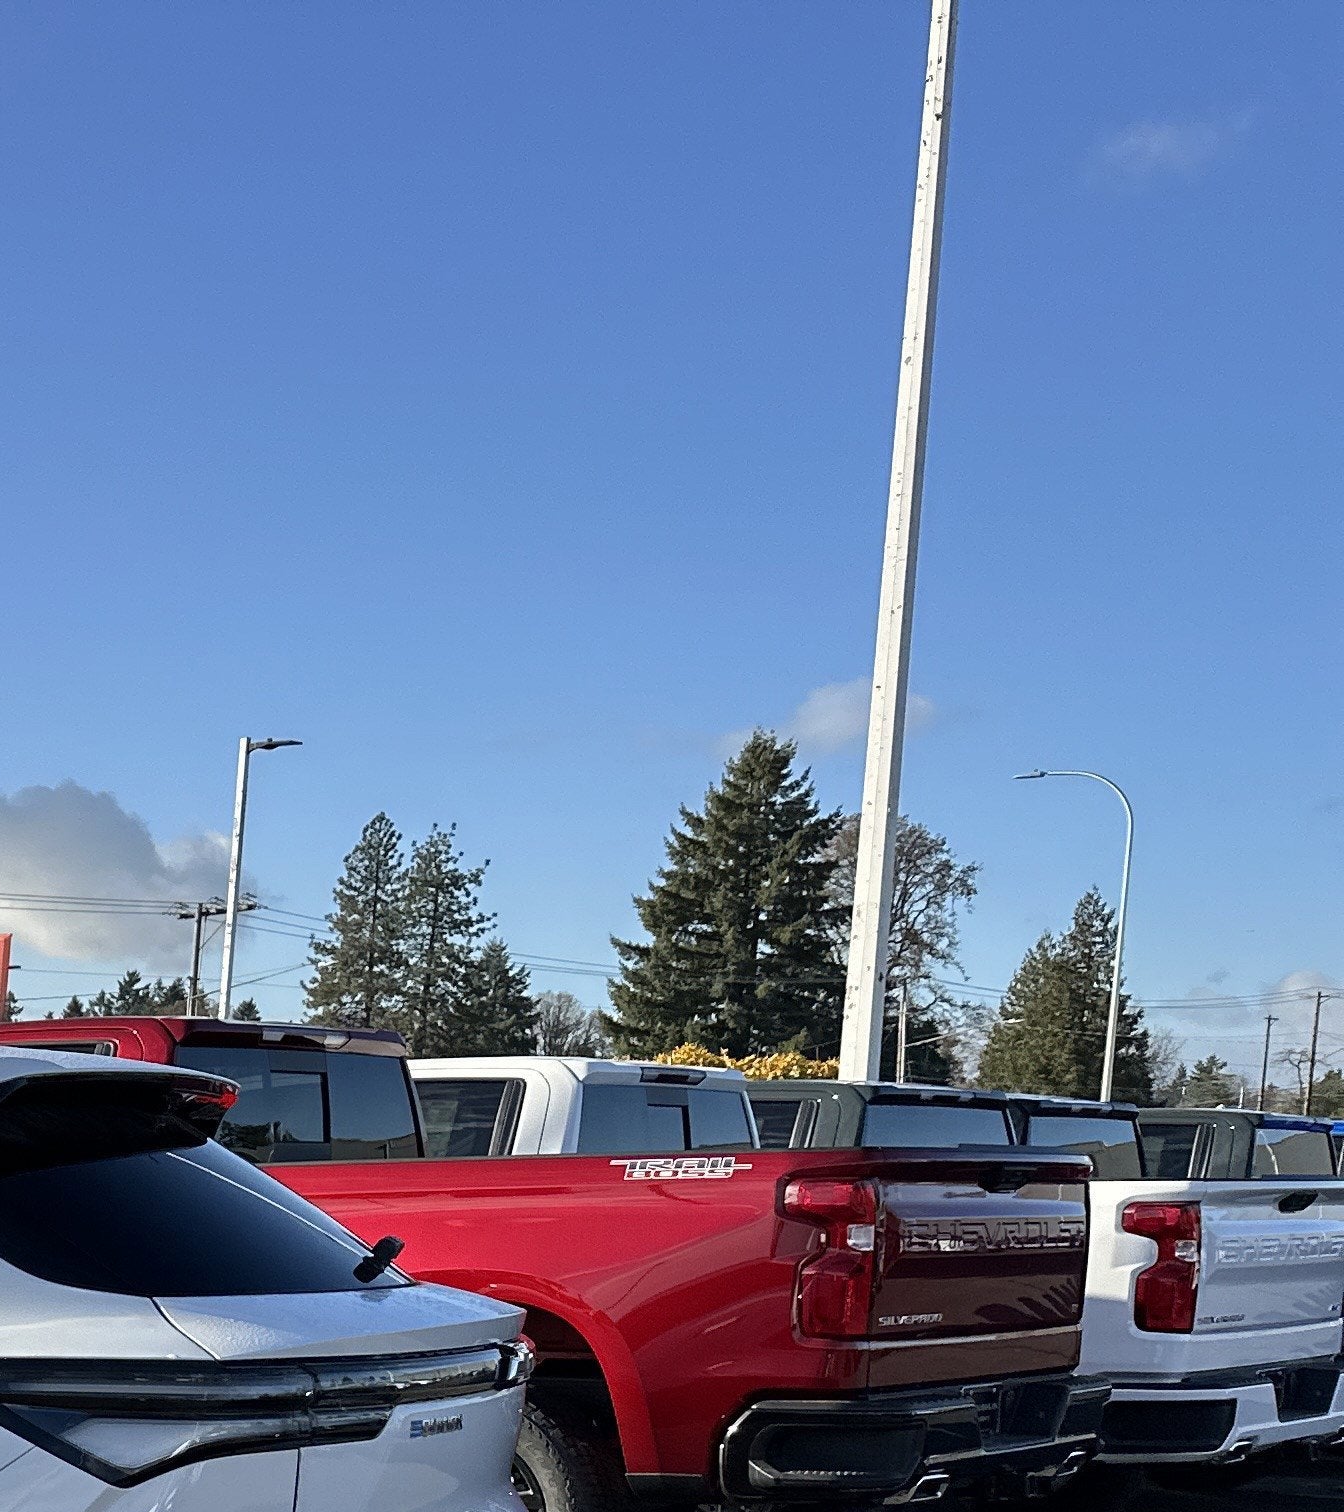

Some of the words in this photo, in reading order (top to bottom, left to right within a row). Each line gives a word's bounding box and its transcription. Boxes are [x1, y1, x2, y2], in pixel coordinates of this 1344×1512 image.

[609, 1157, 753, 1170] TRAIL
[623, 1168, 734, 1181] BOSS
[902, 1220, 1085, 1249] CHEVROLET
[1216, 1234, 1344, 1263] CHEVROLE
[877, 1313, 944, 1326] SILVERADO
